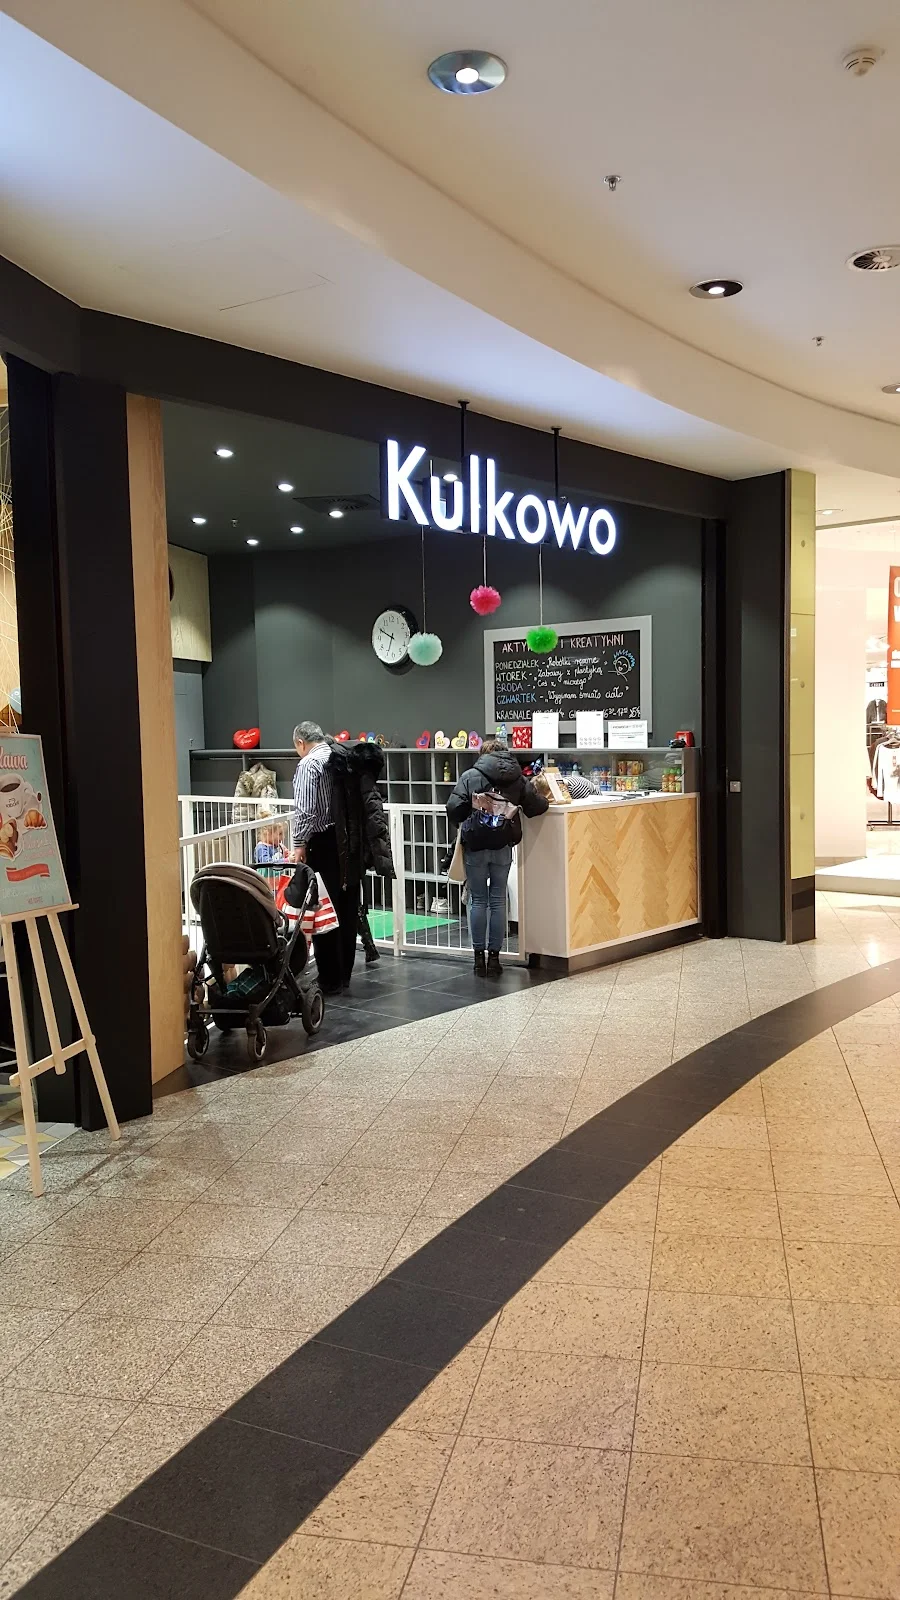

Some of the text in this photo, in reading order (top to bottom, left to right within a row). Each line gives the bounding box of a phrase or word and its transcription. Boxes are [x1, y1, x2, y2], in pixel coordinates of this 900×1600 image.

[386, 438, 617, 556] Kulkowo
[502, 634, 624, 653] AKTY I KREATYWNI
[495, 660, 539, 671] PONIEDZIAŁEK
[495, 670, 528, 682] WTOREK
[495, 682, 523, 693] ŚRODA
[496, 693, 537, 705] CZWARTEK
[496, 710, 532, 720] KRASNALE
